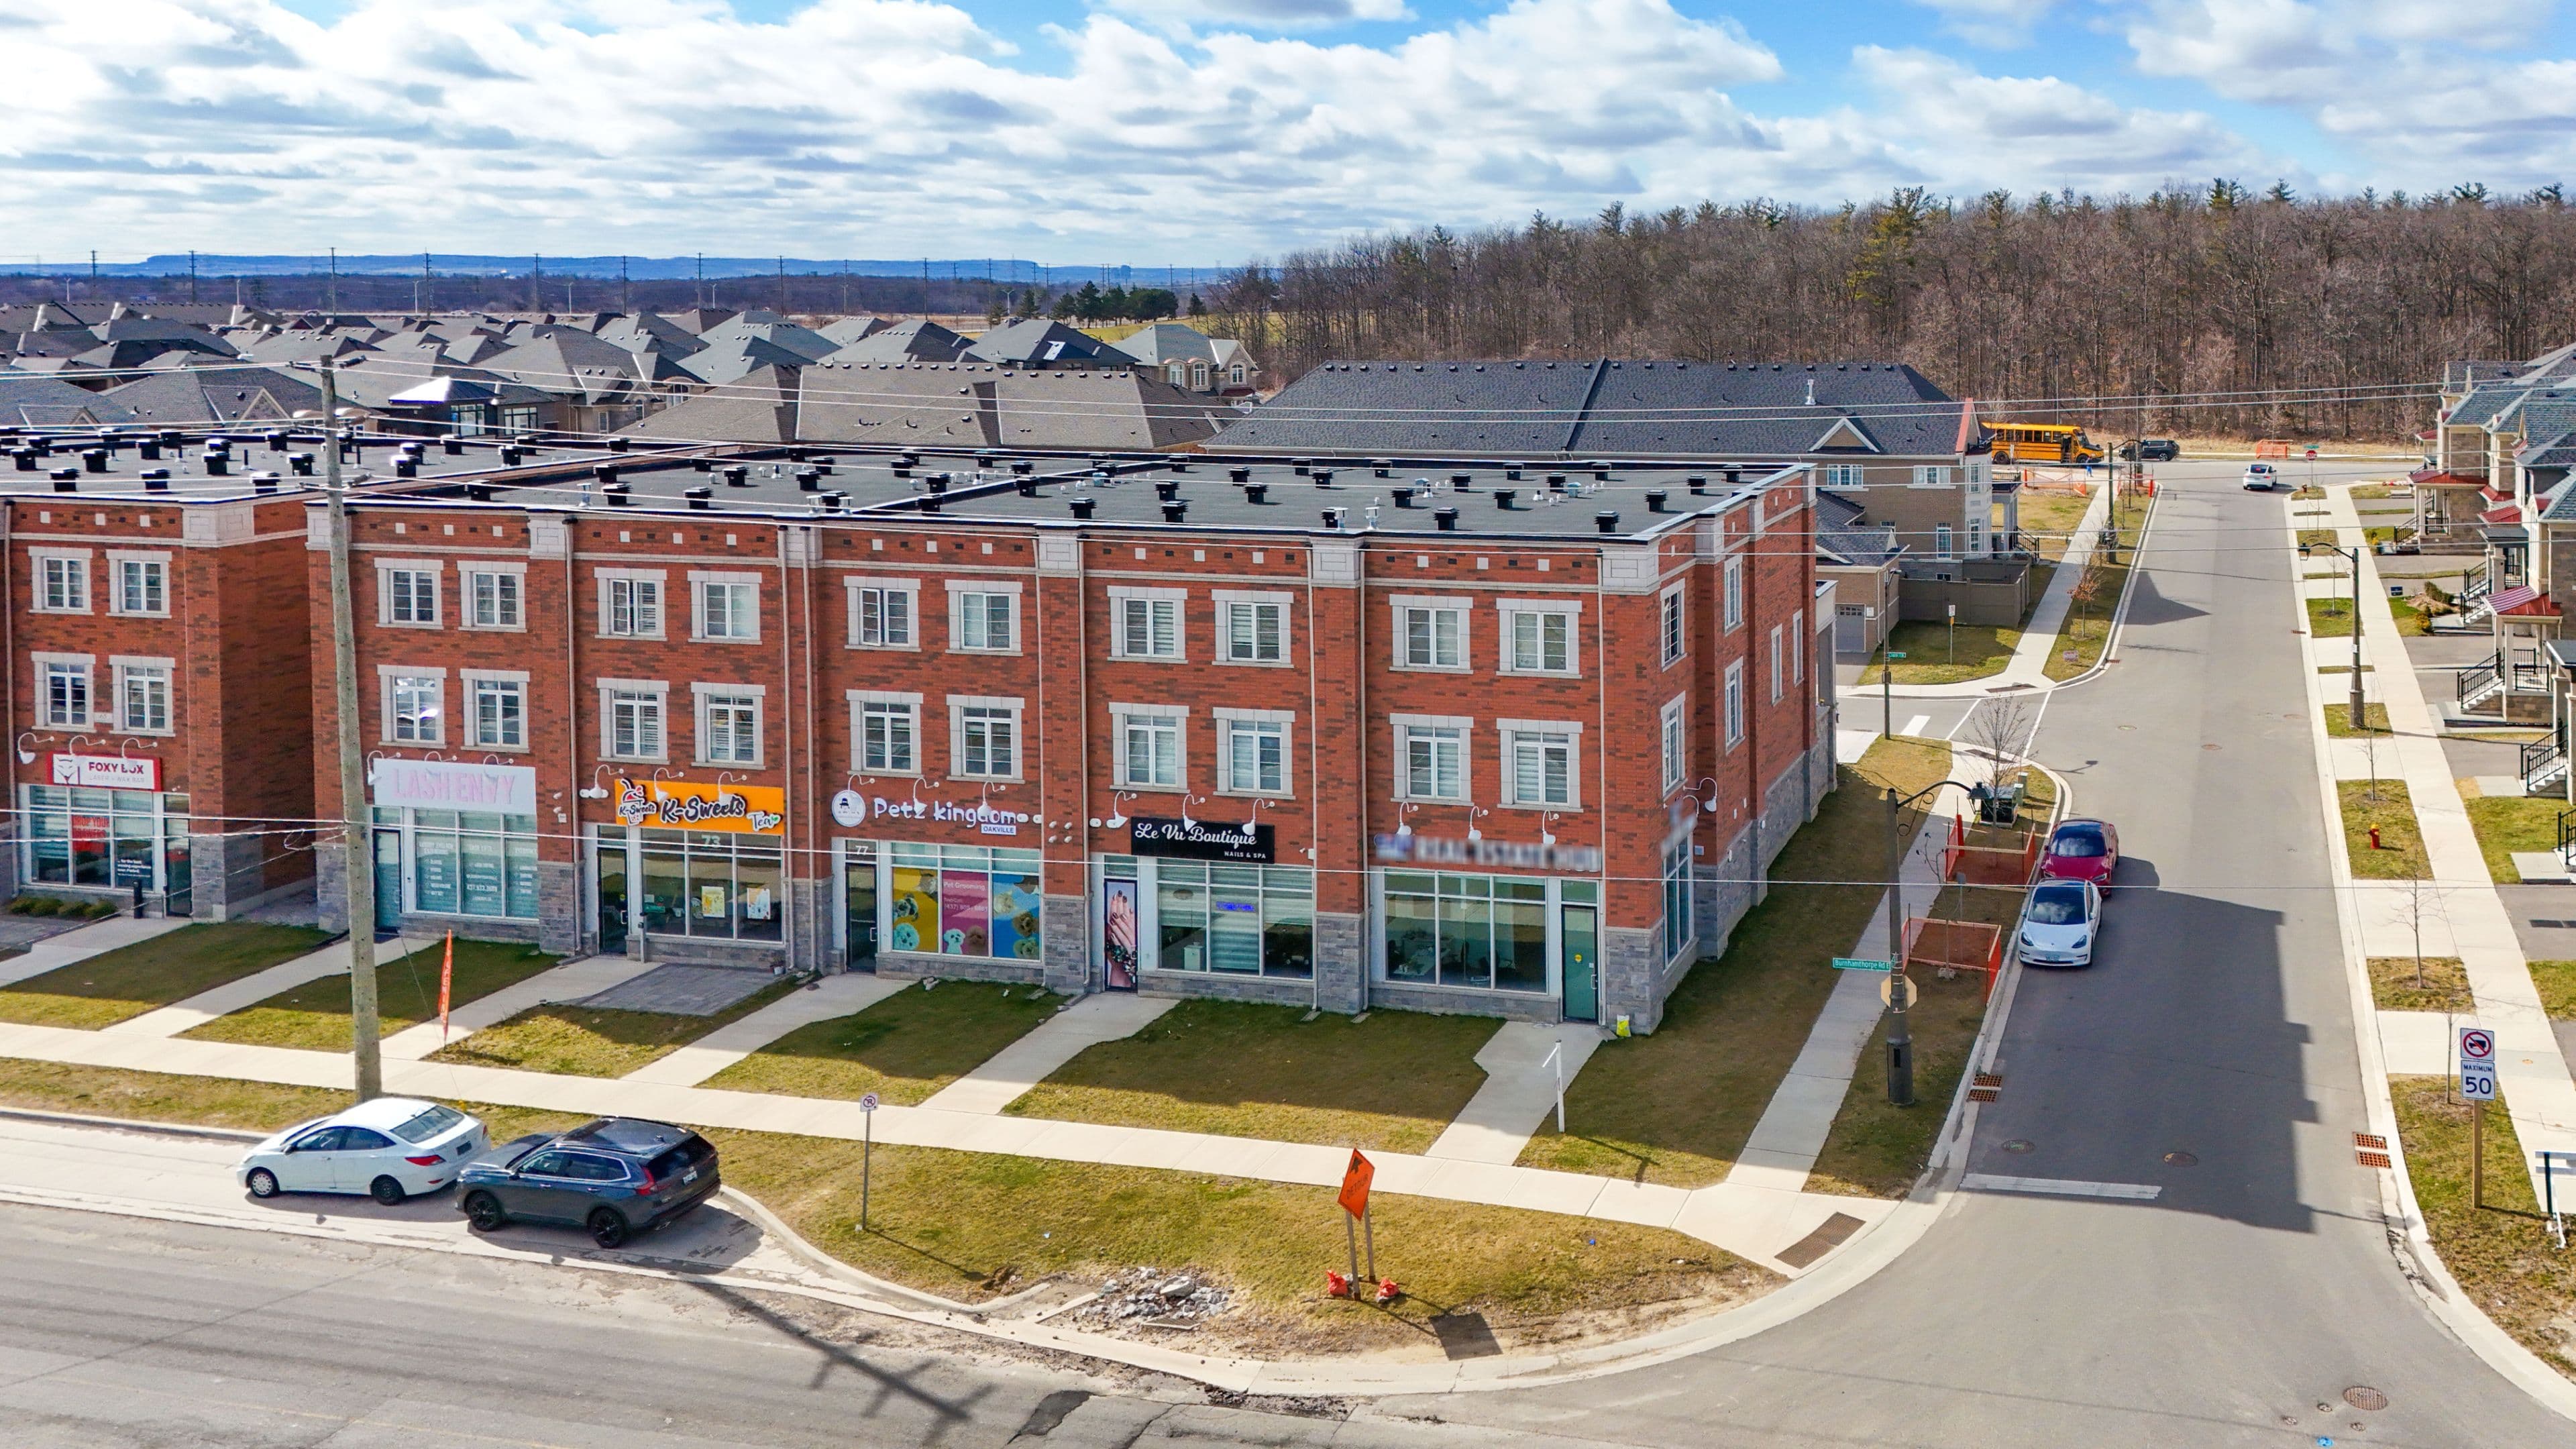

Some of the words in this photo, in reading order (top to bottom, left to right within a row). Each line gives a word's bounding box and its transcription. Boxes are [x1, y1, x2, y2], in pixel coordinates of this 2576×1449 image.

[89, 762, 118, 772] FOXY
[393, 768, 449, 800] LASH
[455, 772, 515, 804] ENVY
[619, 802, 657, 816] K-Sweets
[661, 794, 746, 822] K-Sweets
[873, 797, 925, 819] Petz
[749, 813, 773, 828] Tea
[983, 826, 1014, 834] OAKVILLE
[1135, 823, 1159, 839] Le
[1161, 824, 1185, 840] Vu
[1188, 826, 1257, 849] Boutique
[702, 835, 721, 847] 73
[855, 845, 869, 855] 77
[955, 882, 985, 892] Grooming
[1835, 959, 1878, 969] Burnhamthorpe
[2463, 1064, 2492, 1072] MAXIMUM
[2465, 1076, 2491, 1094] 50
